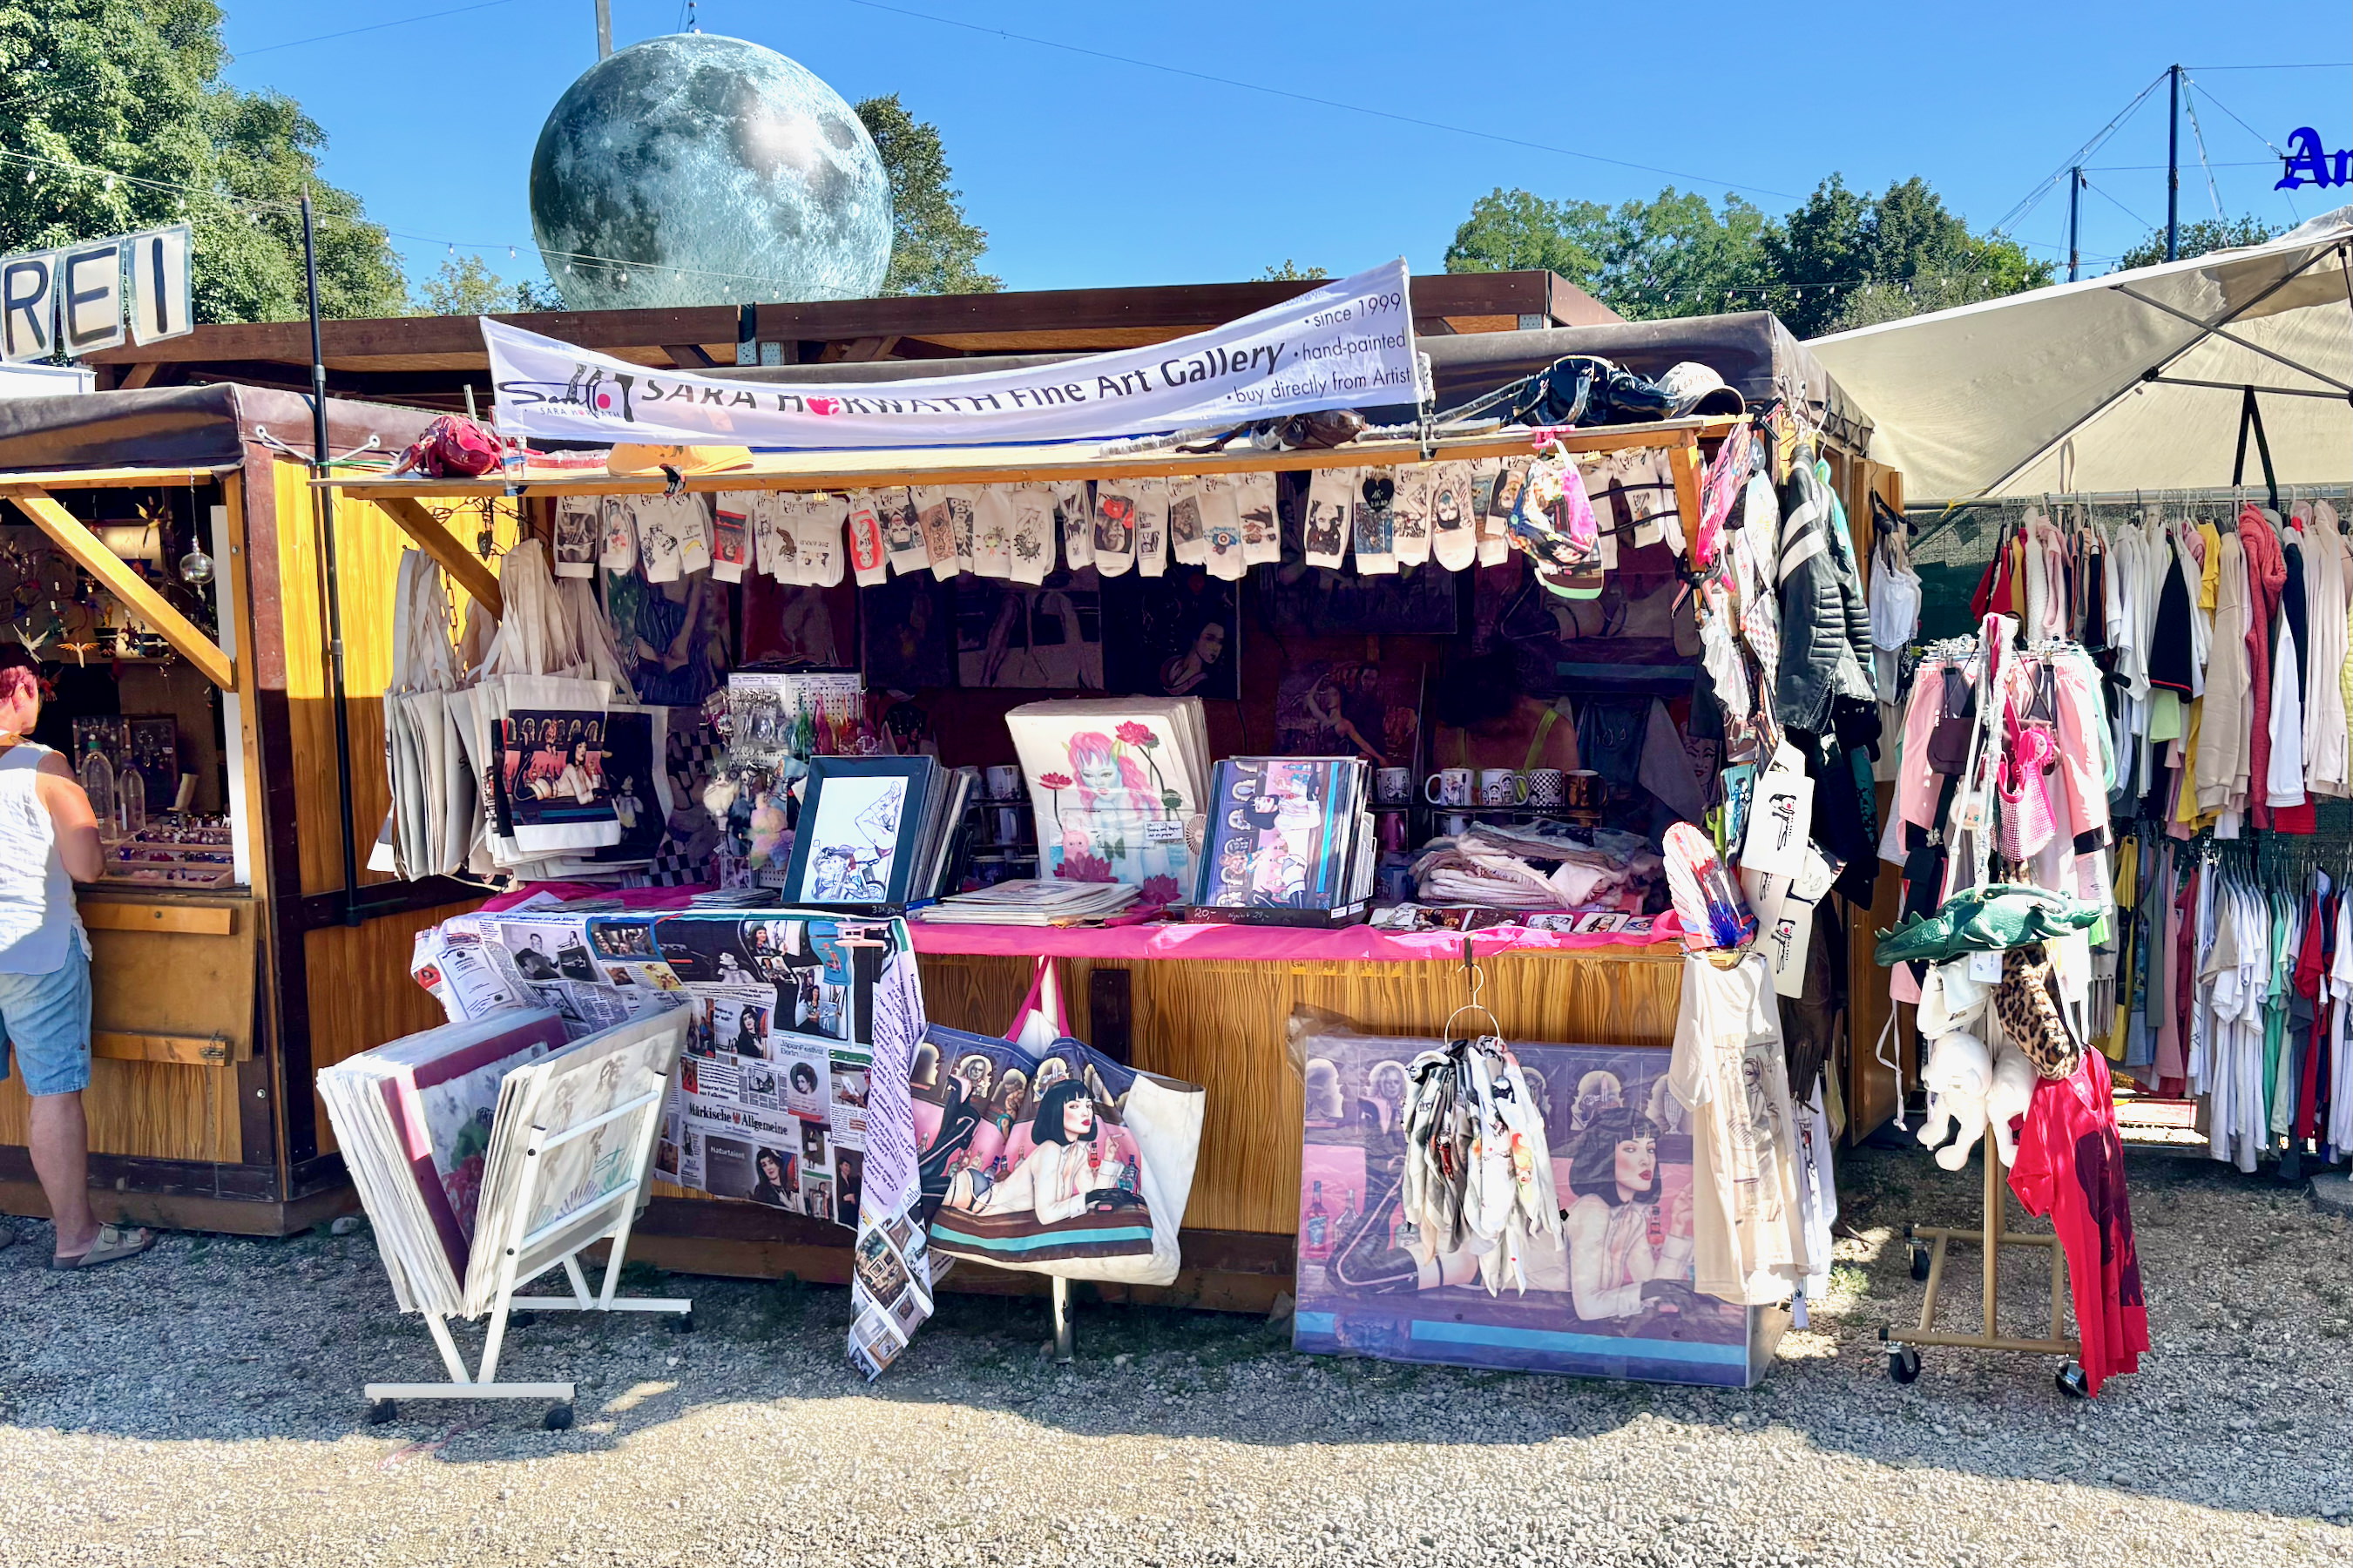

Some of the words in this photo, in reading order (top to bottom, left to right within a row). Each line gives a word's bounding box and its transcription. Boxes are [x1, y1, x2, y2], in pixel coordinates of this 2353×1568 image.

[3, 236, 168, 356] REI
[1314, 308, 1351, 327] since
[1358, 293, 1401, 317] 1999
[1302, 327, 1406, 362] hand-painted
[1007, 383, 1086, 407] Fine
[1098, 369, 1152, 399] Art
[1160, 342, 1285, 387] Gallery
[1234, 386, 1264, 406] buy
[1271, 375, 1328, 398] directly
[1333, 371, 1366, 390] from
[1373, 367, 1410, 386] Artist
[781, 1048, 799, 1057] Berlin
[689, 1102, 732, 1123] Märkische
[741, 1113, 788, 1136] Allgemeine
